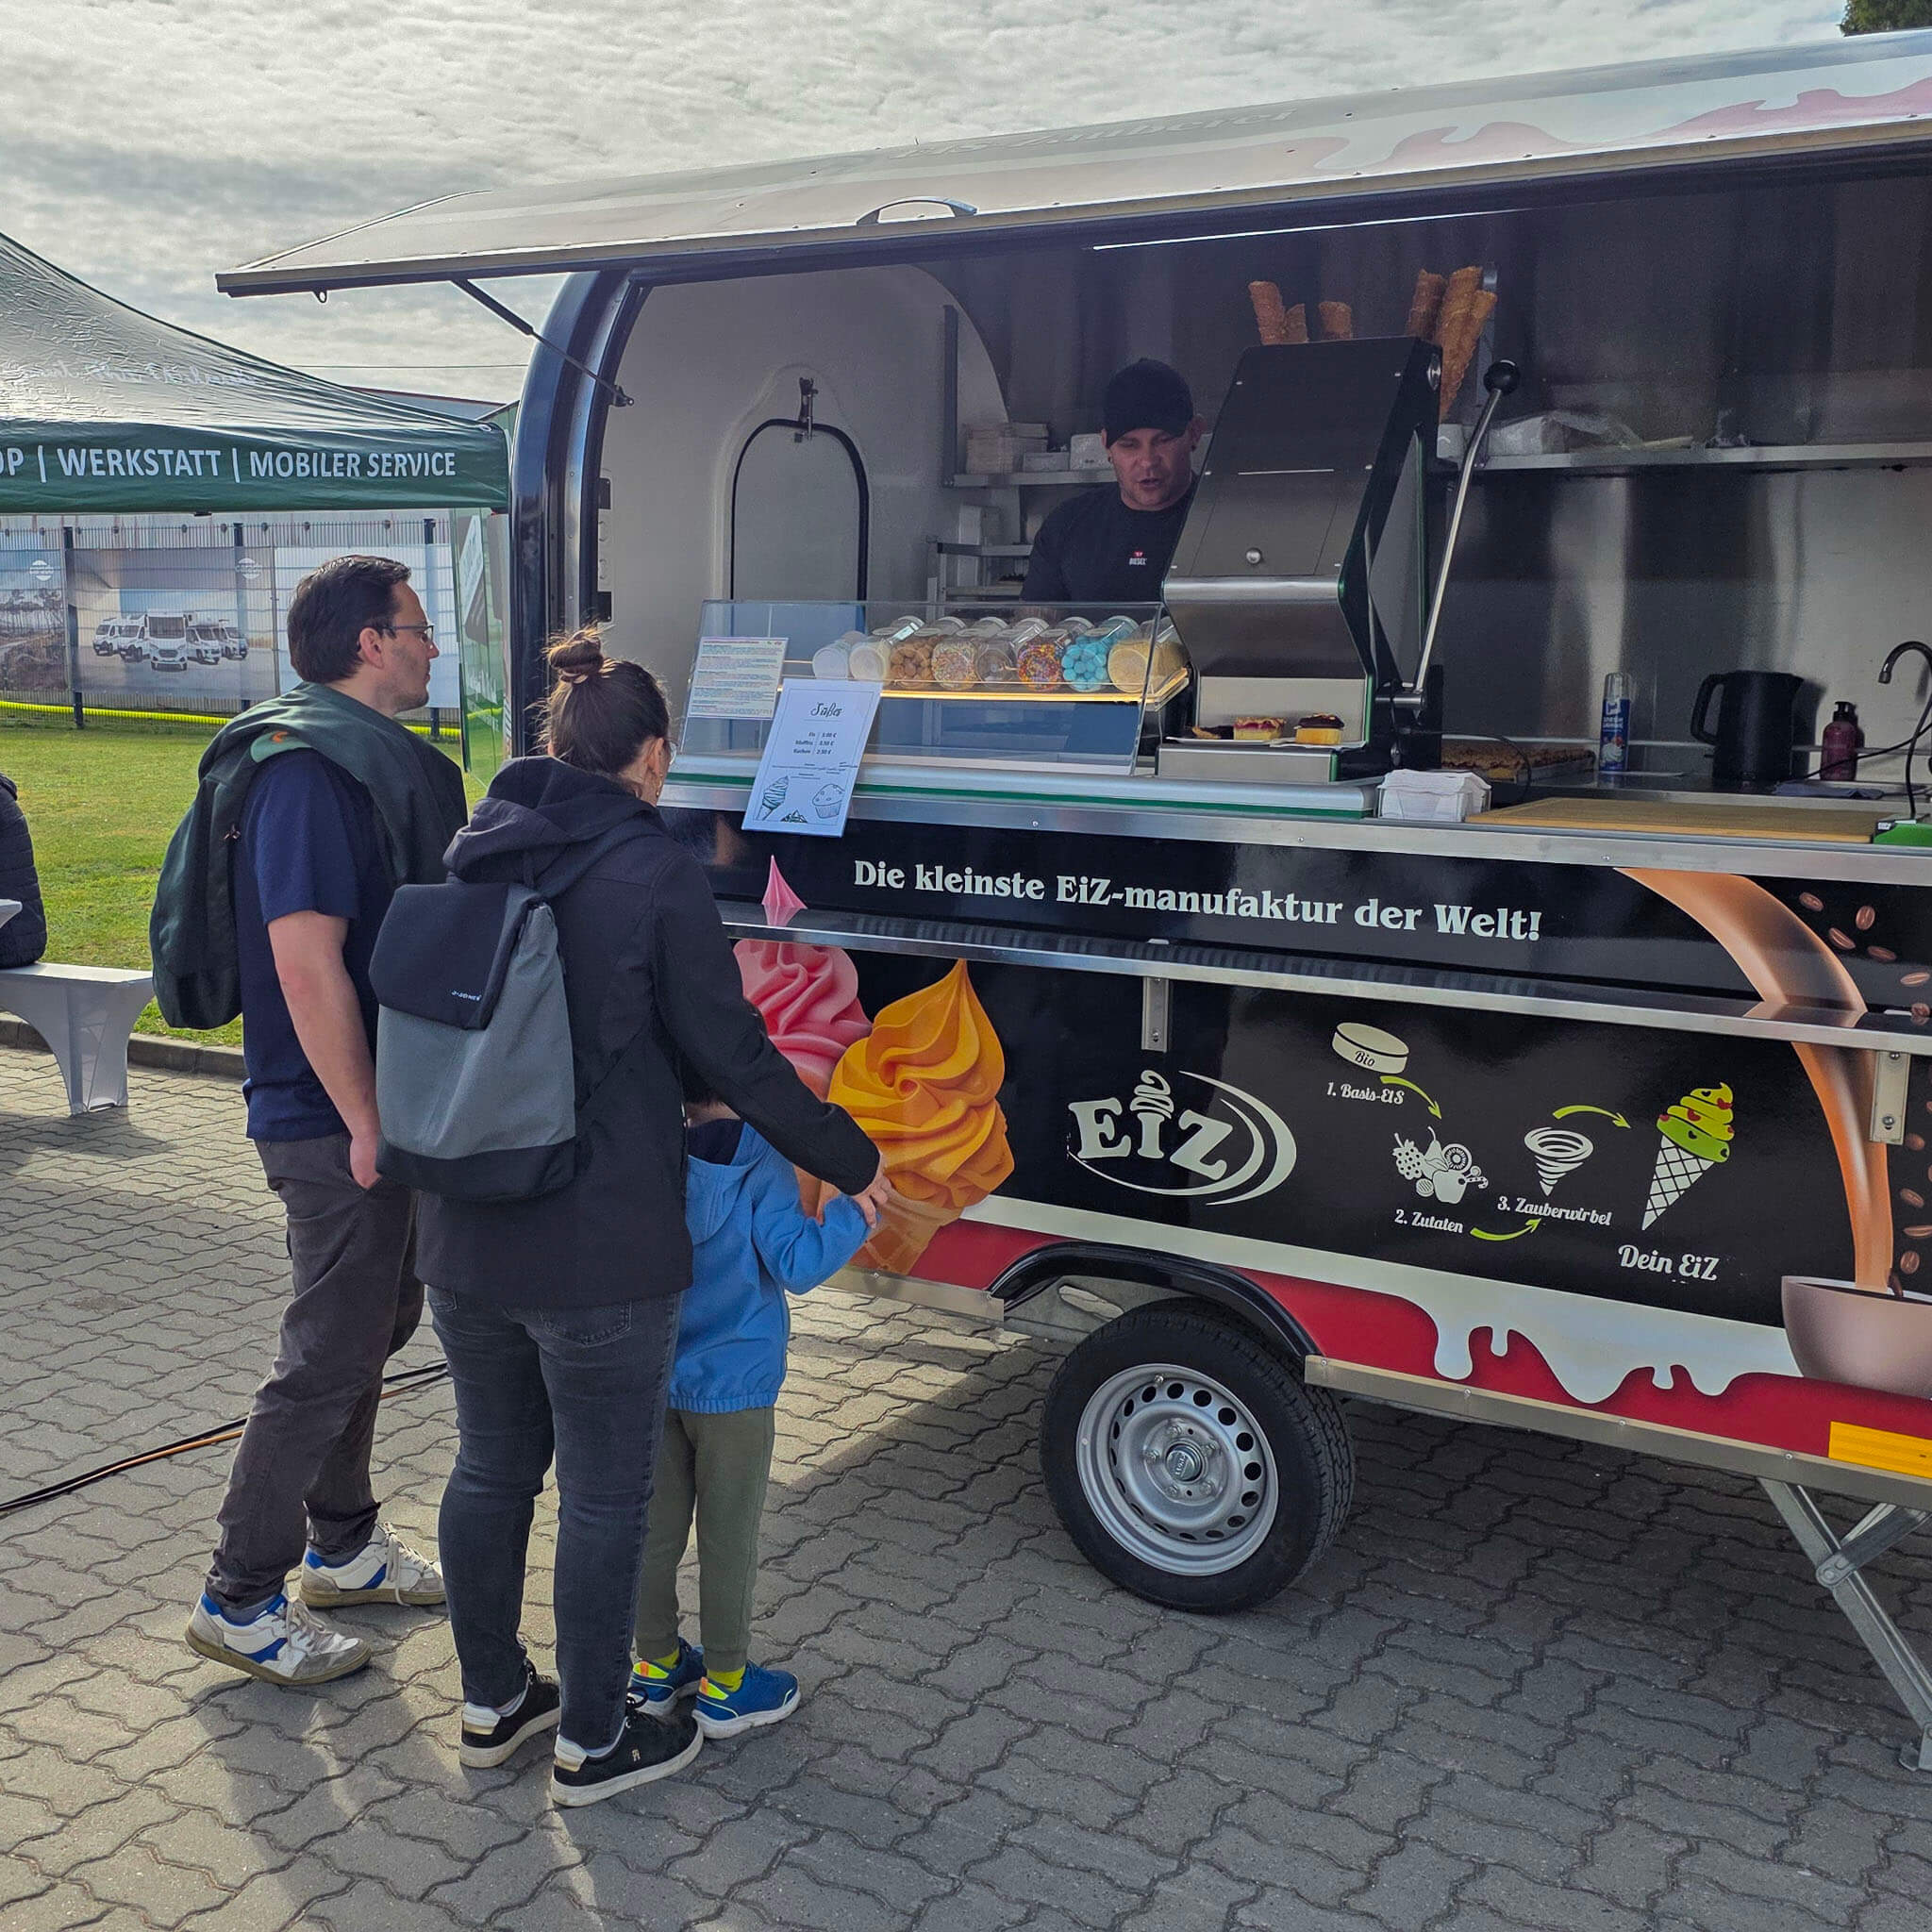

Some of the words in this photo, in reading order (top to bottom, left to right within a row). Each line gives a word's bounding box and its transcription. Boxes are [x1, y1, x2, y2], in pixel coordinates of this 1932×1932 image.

[58, 448, 222, 476] WERKSTATT
[251, 452, 360, 477] MOBILER
[366, 452, 456, 476] SERVICE
[854, 860, 905, 889] Die
[915, 864, 1044, 900] kleinste
[1057, 875, 1343, 924] EiZ-manufaktur
[1354, 899, 1423, 931] der
[1434, 904, 1541, 941] Welt!
[1356, 1050, 1375, 1067] Bio
[1326, 1082, 1337, 1096] 1.
[1394, 1208, 1407, 1224] 2.
[1411, 1211, 1464, 1234] Zutaten
[1497, 1196, 1511, 1212] 3.
[1515, 1197, 1612, 1226] Zauberwirbel
[1618, 1244, 1673, 1274] Dein
[1678, 1254, 1720, 1281] EiZ
